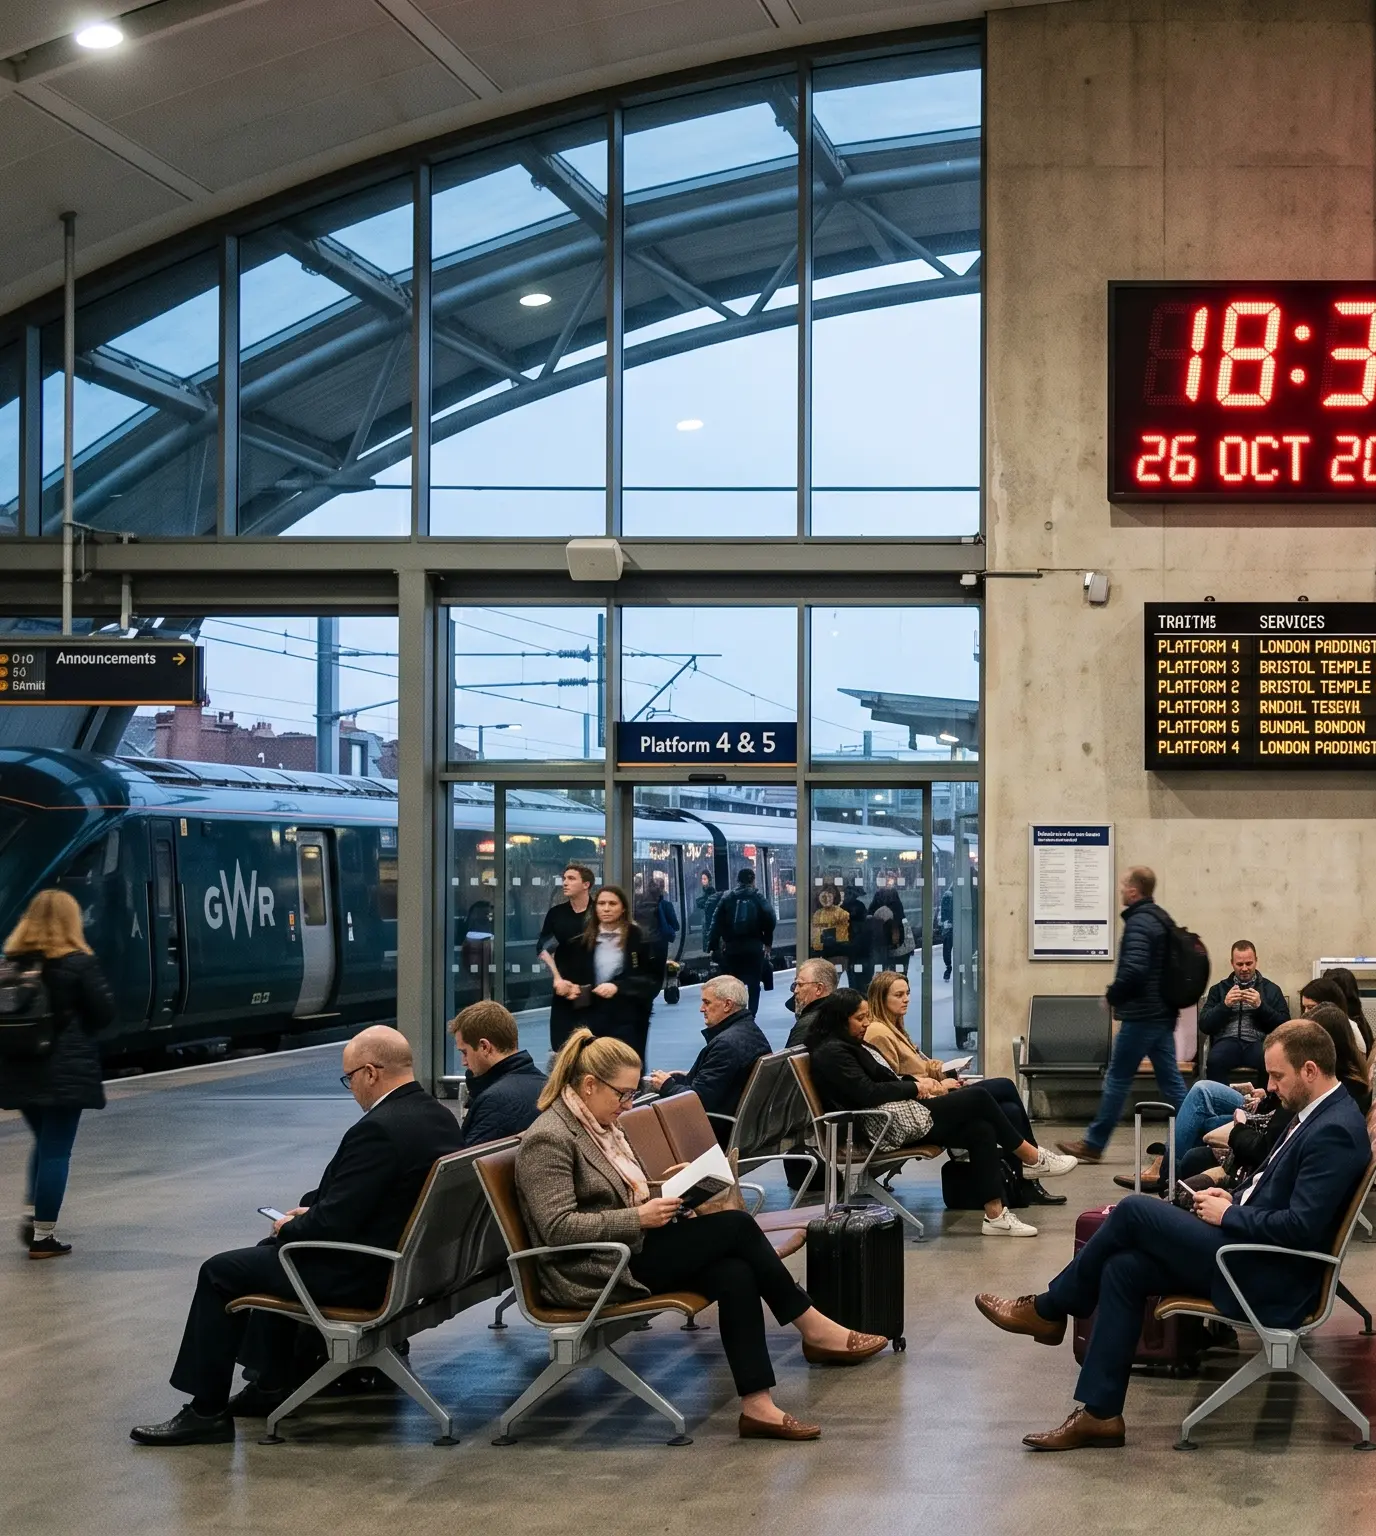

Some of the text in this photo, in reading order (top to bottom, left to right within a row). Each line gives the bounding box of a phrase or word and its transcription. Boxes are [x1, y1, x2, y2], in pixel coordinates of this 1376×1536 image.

[1135, 434, 1198, 484] 26
[1218, 435, 1311, 484] OCT
[1259, 614, 1326, 629] SERVICES
[1158, 639, 1227, 654] PLATFORM
[1231, 639, 1240, 654] 4
[1259, 639, 1311, 654] LONDON
[56, 652, 157, 665] Announcements
[1158, 660, 1227, 675] PLATFORM
[1231, 660, 1240, 675] 3
[1259, 660, 1316, 675] BRISTOL
[1320, 660, 1372, 675] TEMPLE
[1158, 679, 1227, 694] PLATFORM
[1231, 679, 1240, 694] 2
[1259, 679, 1316, 694] BRISTOL
[1320, 679, 1372, 694] TEMPLE
[1158, 700, 1227, 715] PLATFORM
[1231, 700, 1240, 715] 3
[1158, 720, 1227, 735] PLATFORM
[1231, 720, 1240, 735] 5
[1314, 720, 1366, 735] BONDON
[640, 731, 776, 753] Platform 4 & 5
[1158, 740, 1227, 755] PLATFORM
[1231, 740, 1240, 755] 4
[1259, 740, 1311, 755] LONDON
[204, 858, 276, 940] GWR
